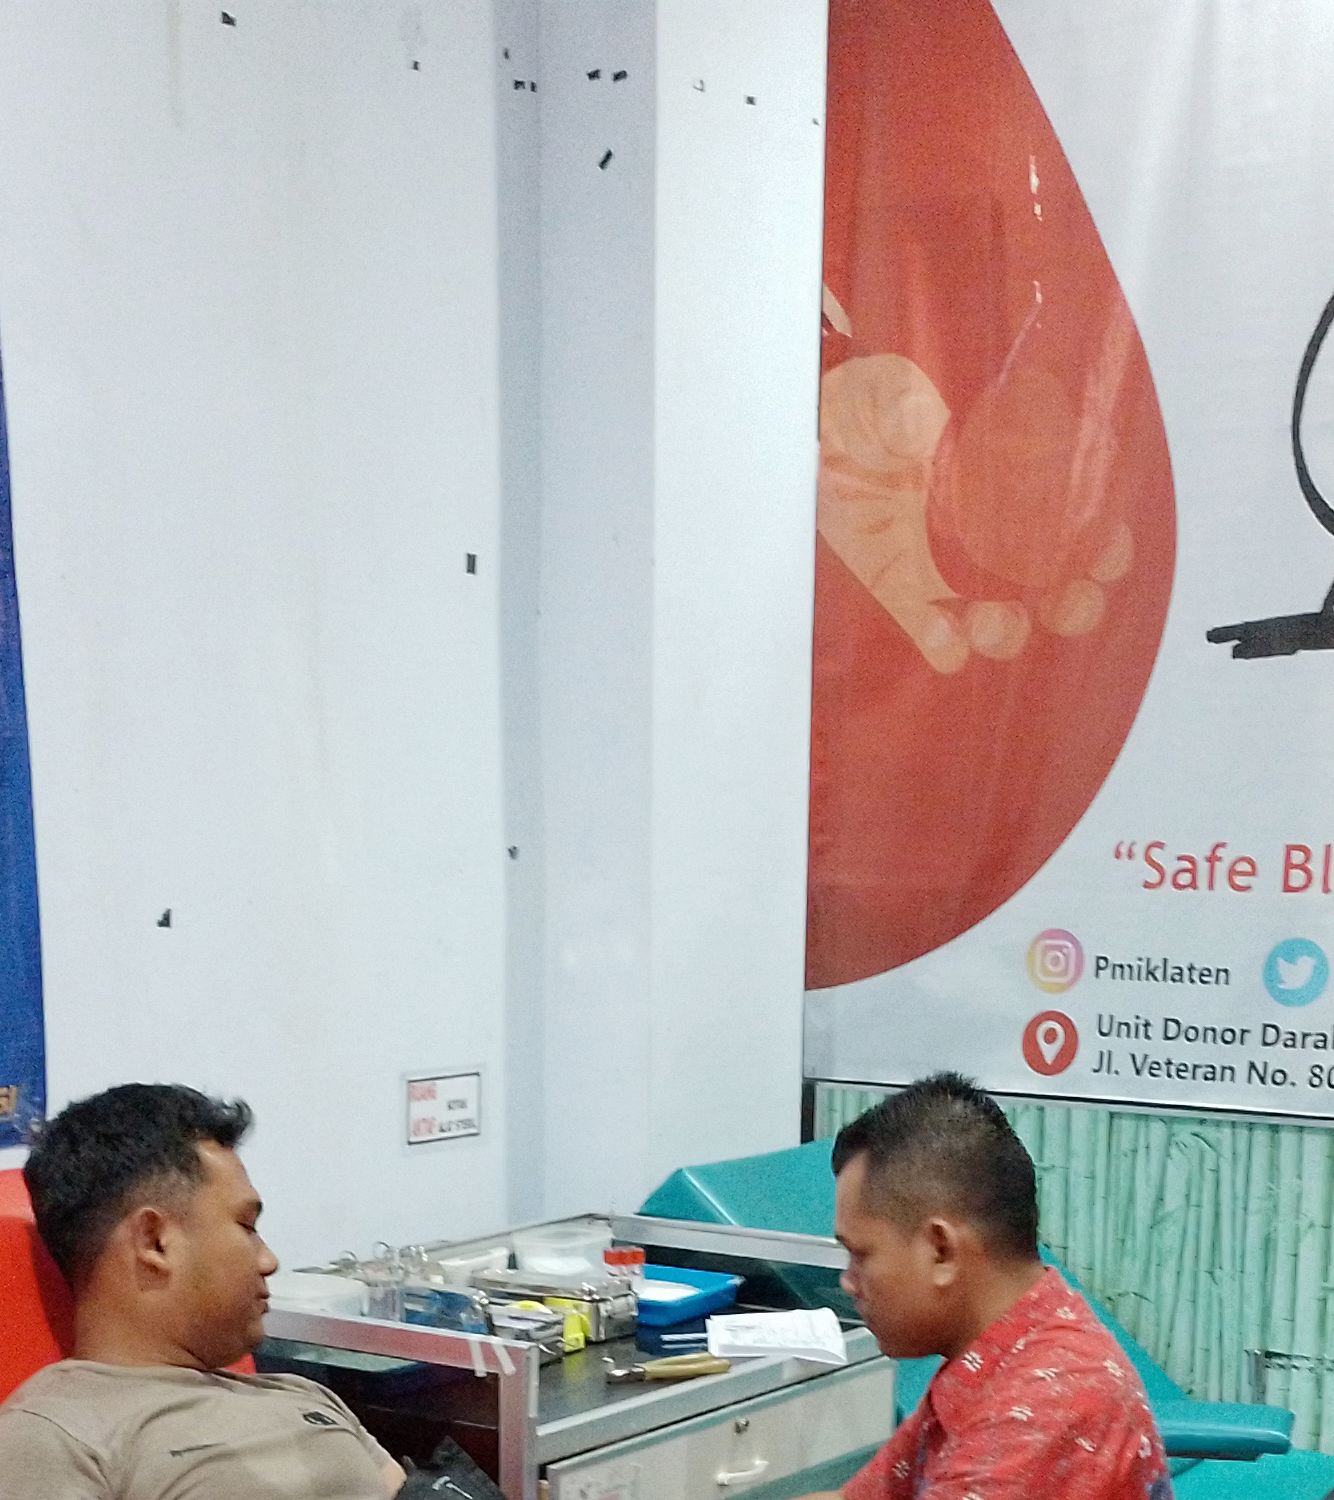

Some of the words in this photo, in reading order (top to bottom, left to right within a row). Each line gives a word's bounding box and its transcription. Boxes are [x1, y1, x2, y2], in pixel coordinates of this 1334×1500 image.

[1094, 955, 1231, 986] Pmiklaten
[1096, 1014, 1153, 1042] Unit
[1162, 1018, 1252, 1048] Donor
[1090, 1052, 1120, 1078] Jl.
[1130, 1053, 1236, 1085] Veteran
[1246, 1061, 1297, 1089] No.
